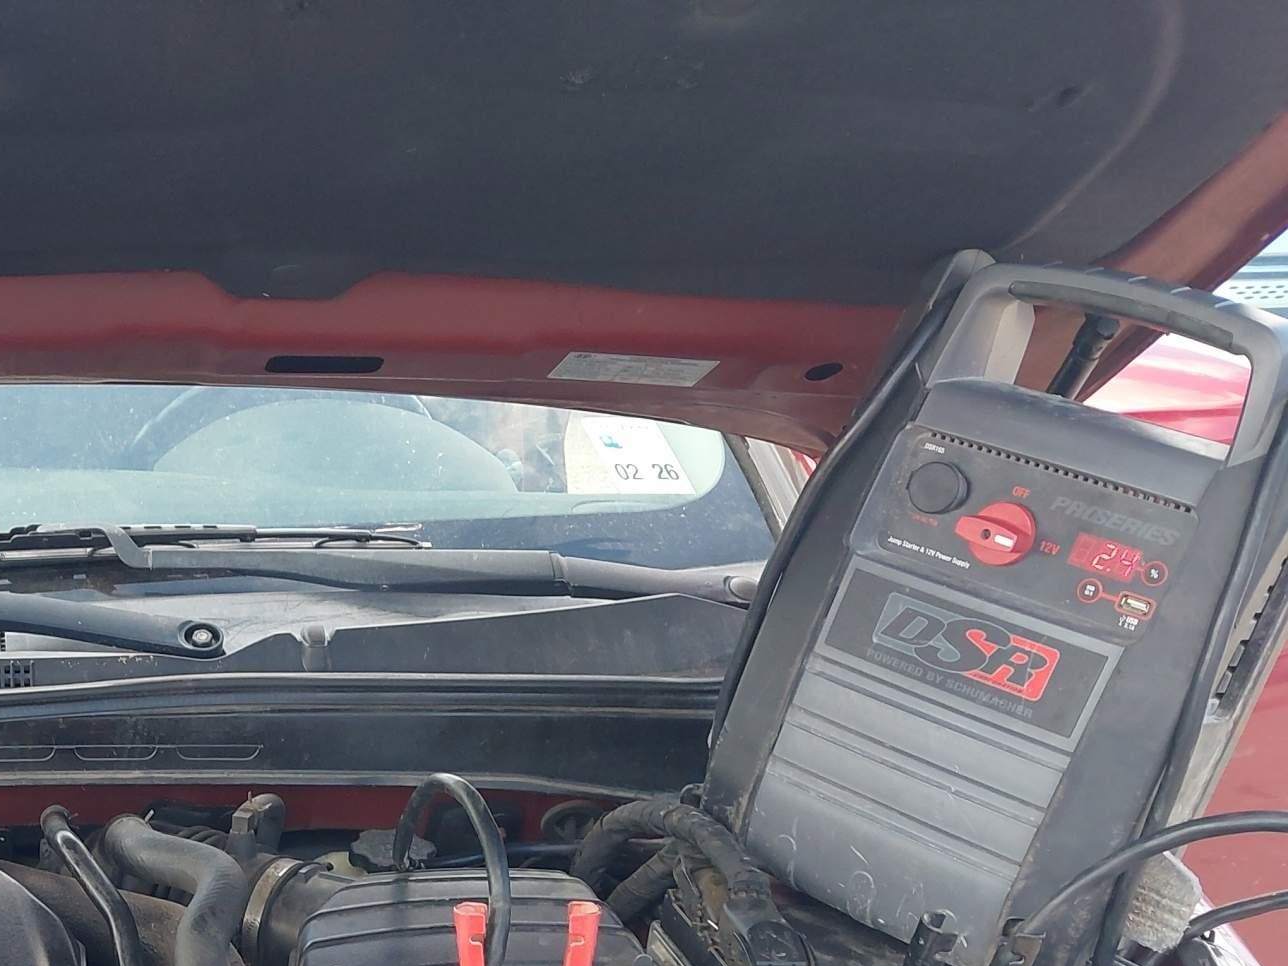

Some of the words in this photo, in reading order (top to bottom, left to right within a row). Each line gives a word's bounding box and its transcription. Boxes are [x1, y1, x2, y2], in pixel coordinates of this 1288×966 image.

[615, 463, 644, 480] 02
[652, 463, 680, 480] 26
[1012, 485, 1031, 498] OFF
[1050, 496, 1181, 546] PROSERIES
[887, 536, 903, 548] Jump
[902, 540, 920, 552] Starter
[925, 548, 935, 557] 12V
[935, 551, 952, 563] Power
[951, 555, 970, 569] Supply
[1039, 540, 1061, 555] 12V
[1150, 568, 1159, 579] %
[879, 605, 1050, 689] DSR
[866, 649, 925, 677] POWERED
[925, 669, 945, 685] BY
[945, 677, 1034, 719] SCHUMACHER
